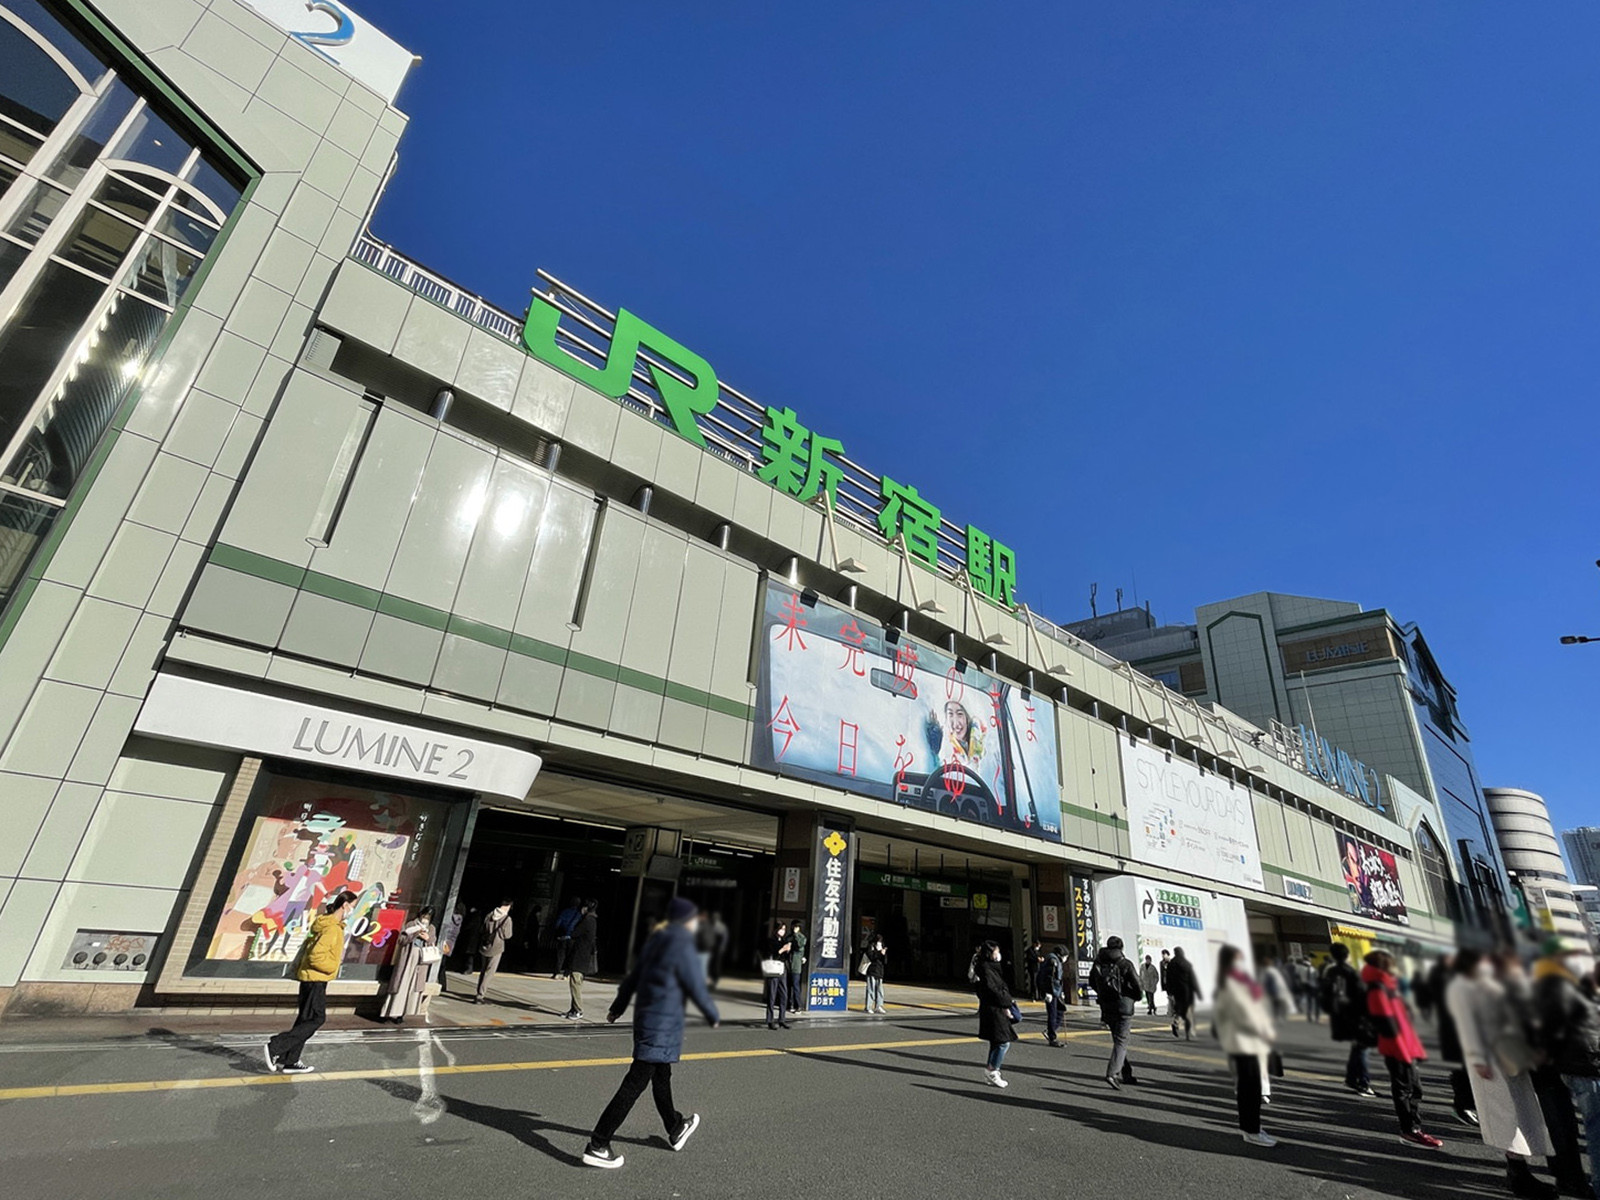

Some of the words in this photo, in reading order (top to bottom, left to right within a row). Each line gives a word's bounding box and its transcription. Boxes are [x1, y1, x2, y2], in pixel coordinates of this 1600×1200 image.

[288, 0, 355, 65] 2
[522, 296, 719, 449] JR
[757, 405, 1018, 608] 新宿駅
[773, 592, 1039, 743] 未完成のまま
[292, 716, 447, 776] LUMINE
[448, 748, 476, 781] 2
[1136, 758, 1182, 802] STYLE
[1182, 774, 1218, 816] YOUR
[1299, 722, 1375, 807] LUMINE
[1369, 768, 1386, 813] 2
[821, 857, 842, 959] 住友不動産
[1074, 887, 1085, 948] ステップ
[1081, 878, 1095, 959] すみふの仲介
